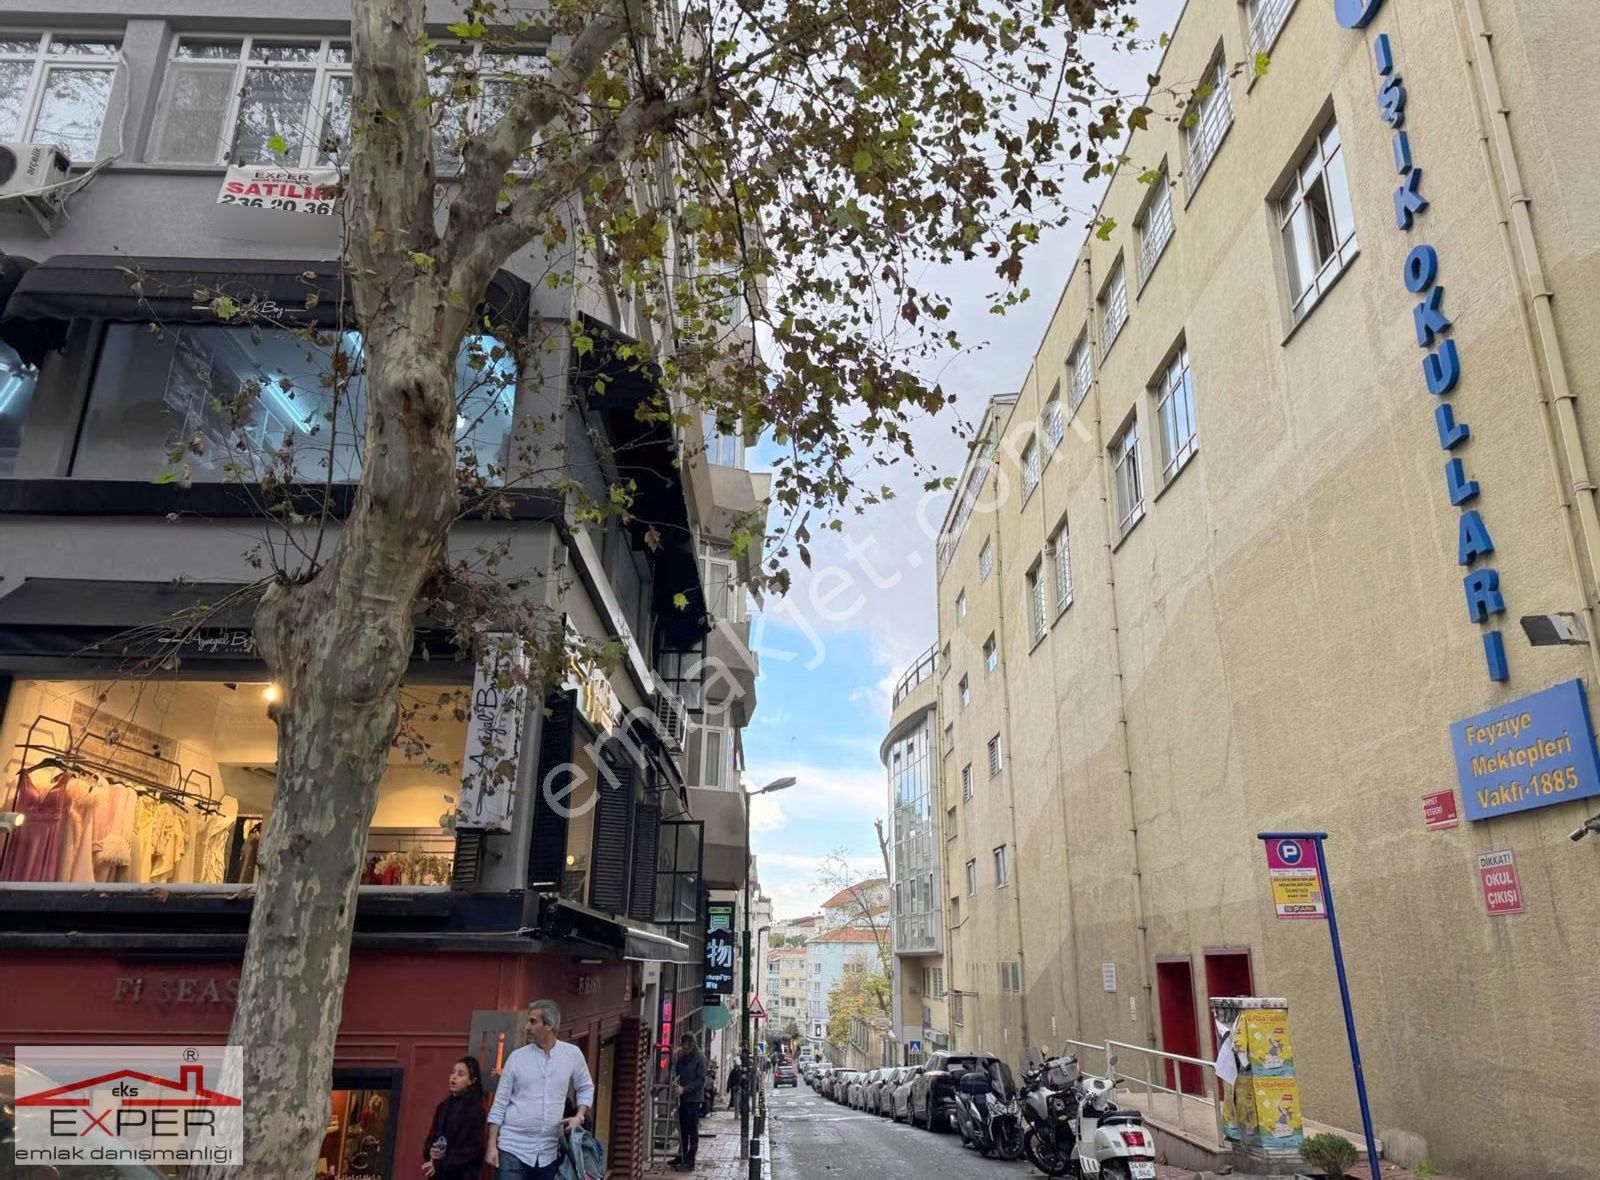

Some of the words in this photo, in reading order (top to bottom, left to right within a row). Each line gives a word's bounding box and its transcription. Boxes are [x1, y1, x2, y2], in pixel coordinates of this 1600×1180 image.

[254, 172, 309, 180] EXPER
[1373, 33, 1430, 231] IŞIK
[1404, 244, 1510, 681] OKULLARI
[1466, 712, 1531, 746] Feyziye
[1471, 730, 1572, 777] Mektepleri
[1481, 854, 1510, 868] DİKKAT!
[1486, 872, 1513, 886] OKUL
[1488, 890, 1518, 908] ÇIKIŞI
